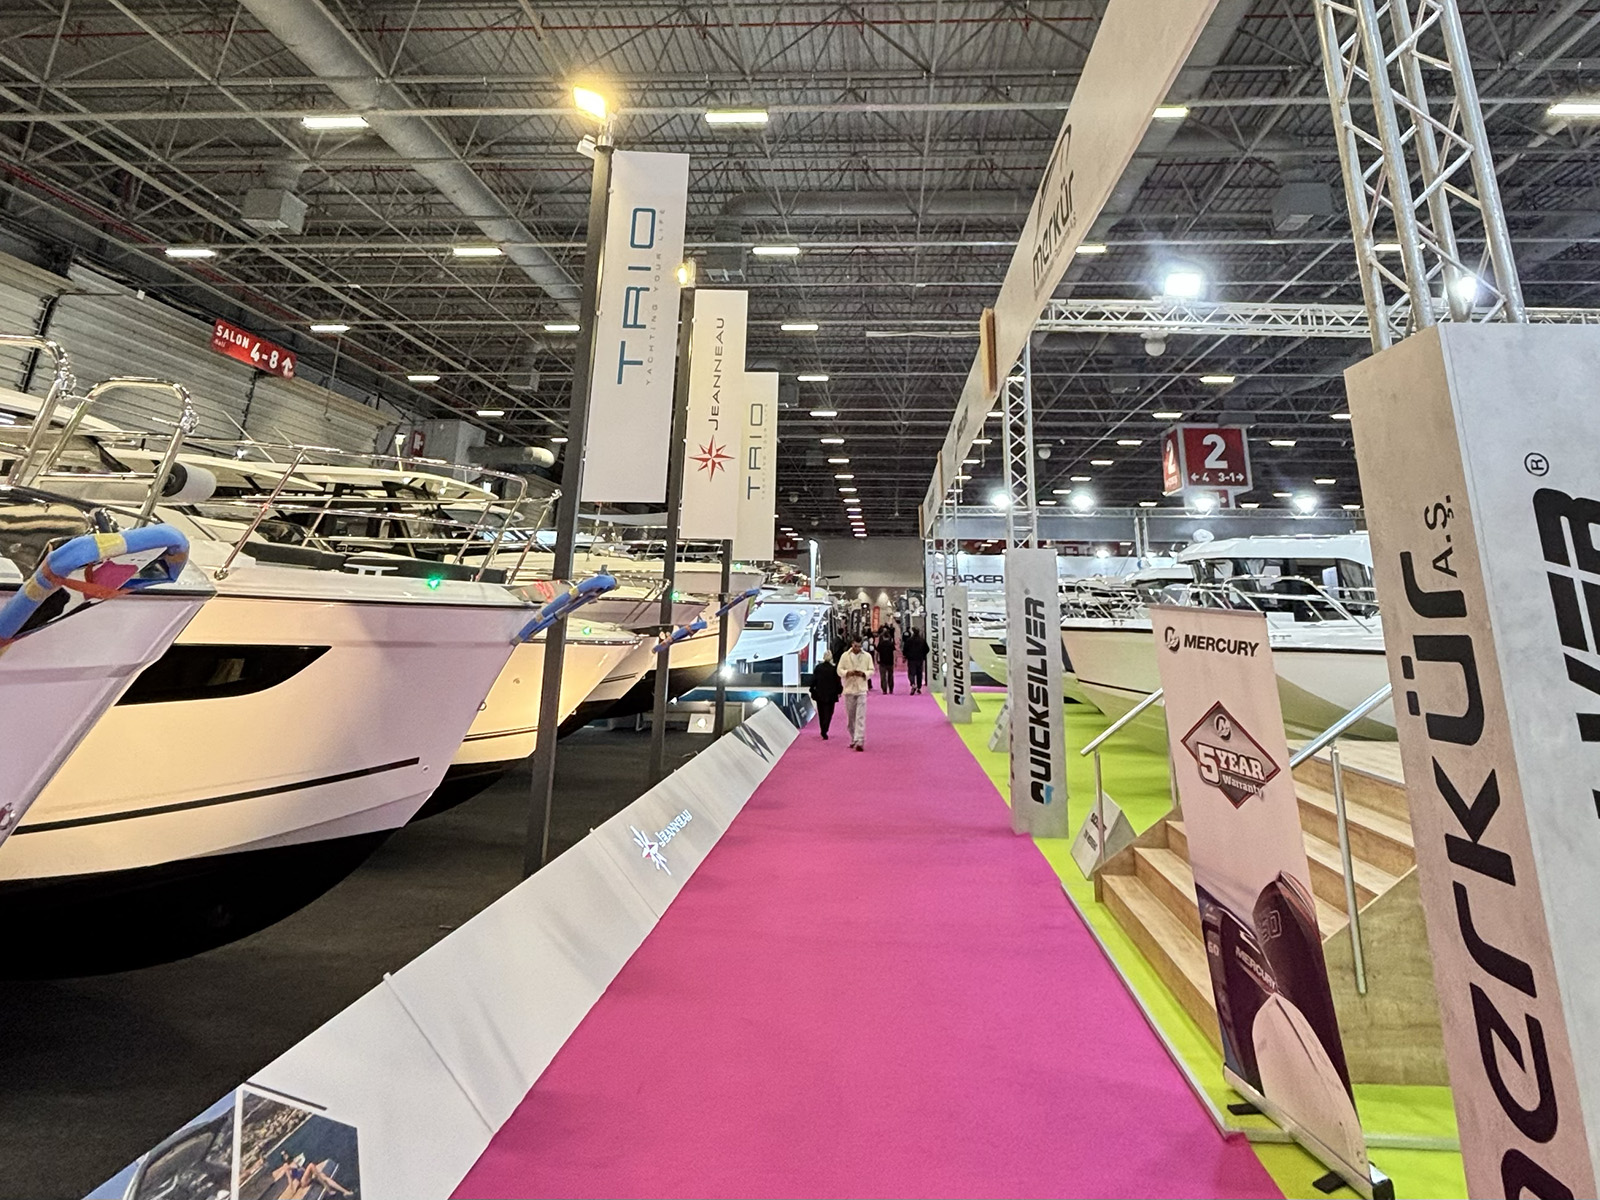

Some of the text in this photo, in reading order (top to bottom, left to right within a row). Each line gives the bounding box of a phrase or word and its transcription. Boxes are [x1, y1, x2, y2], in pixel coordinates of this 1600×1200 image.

[616, 207, 657, 385] TRIO
[645, 304, 659, 387] YACHTING
[652, 252, 662, 293] YOUR
[215, 324, 280, 369] SALON 4-8
[708, 317, 725, 431] JEANNEAU
[747, 403, 763, 500] TRIO
[1166, 439, 1177, 475] 2
[1202, 433, 1229, 469] 2
[1202, 472, 1235, 483] 4 3-1
[952, 607, 964, 706] QUICKSILVER
[1183, 634, 1260, 657] MERCURY
[1024, 596, 1055, 806] QUICKSILVER
[1197, 743, 1265, 784] 5 YEAR
[1221, 774, 1265, 800] Warranty
[1400, 551, 1576, 1200] erkür
